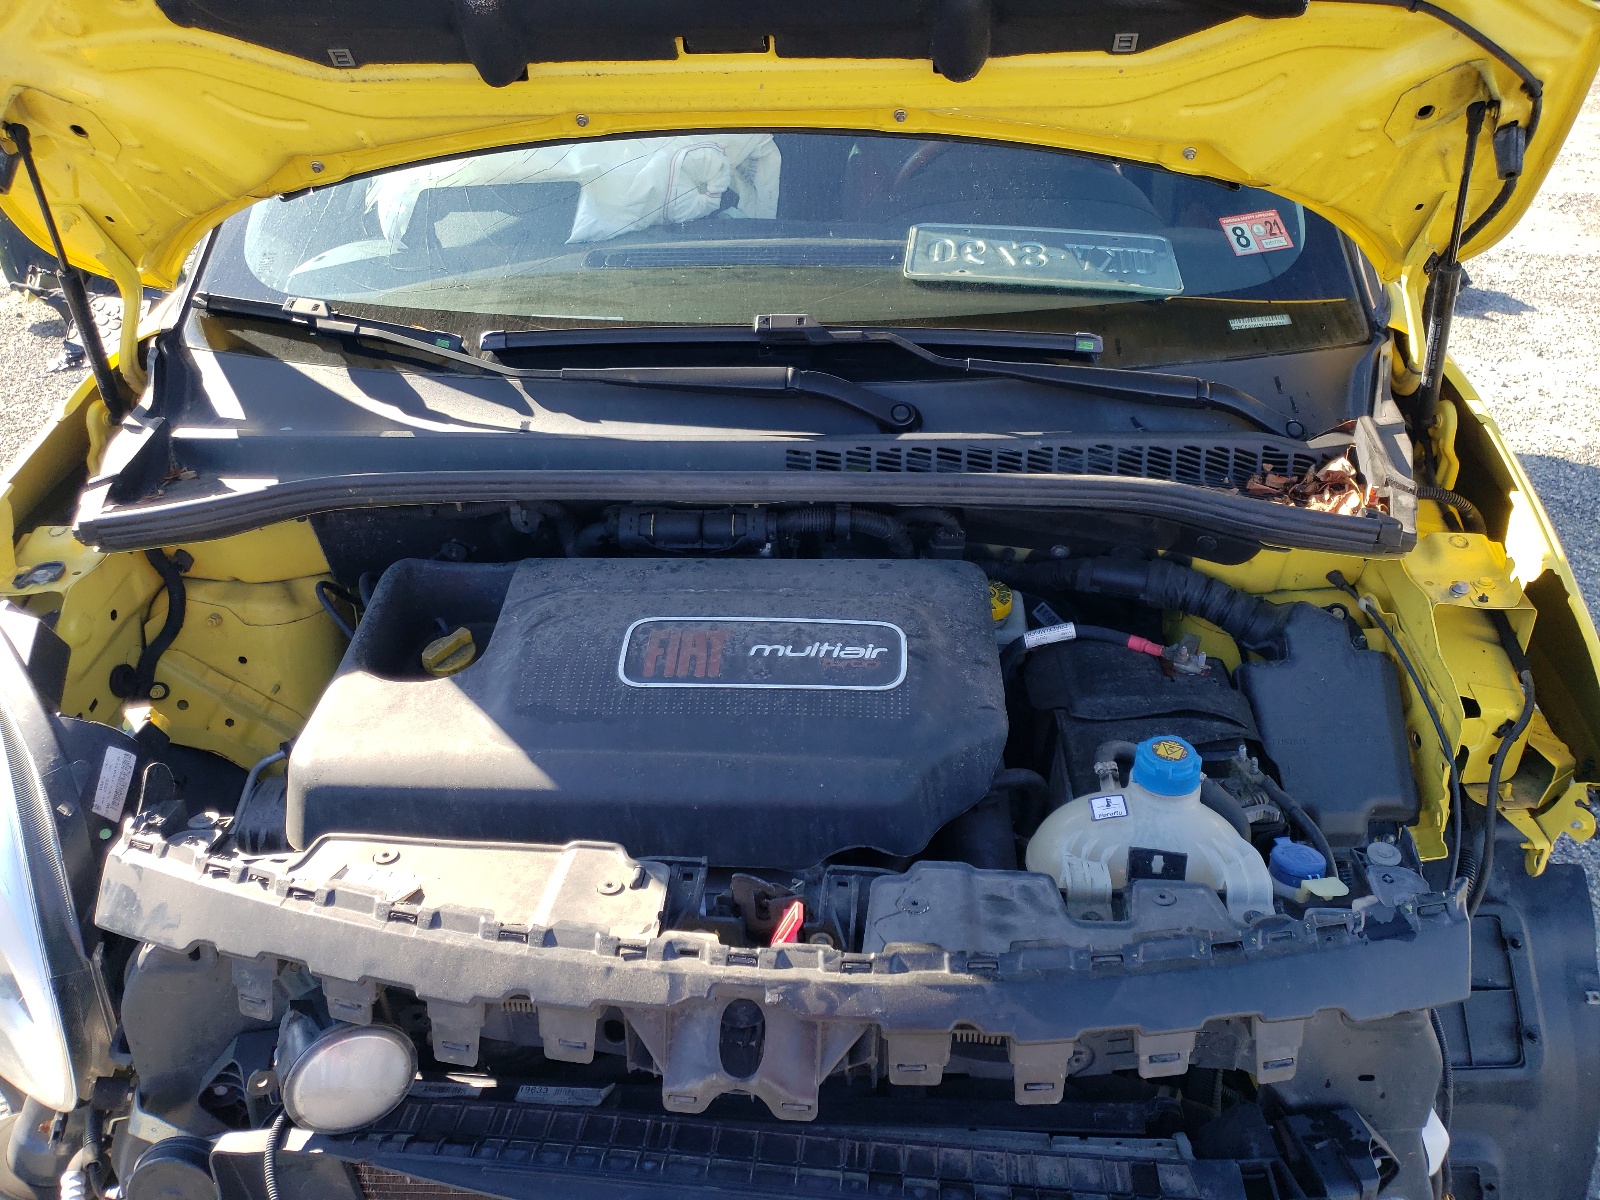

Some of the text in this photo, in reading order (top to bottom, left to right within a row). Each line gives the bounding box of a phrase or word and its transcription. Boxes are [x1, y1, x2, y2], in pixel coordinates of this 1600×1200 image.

[1232, 226, 1250, 248] 8
[1264, 219, 1283, 236] 21
[643, 629, 733, 678] FIAT
[749, 641, 888, 659] multiair
